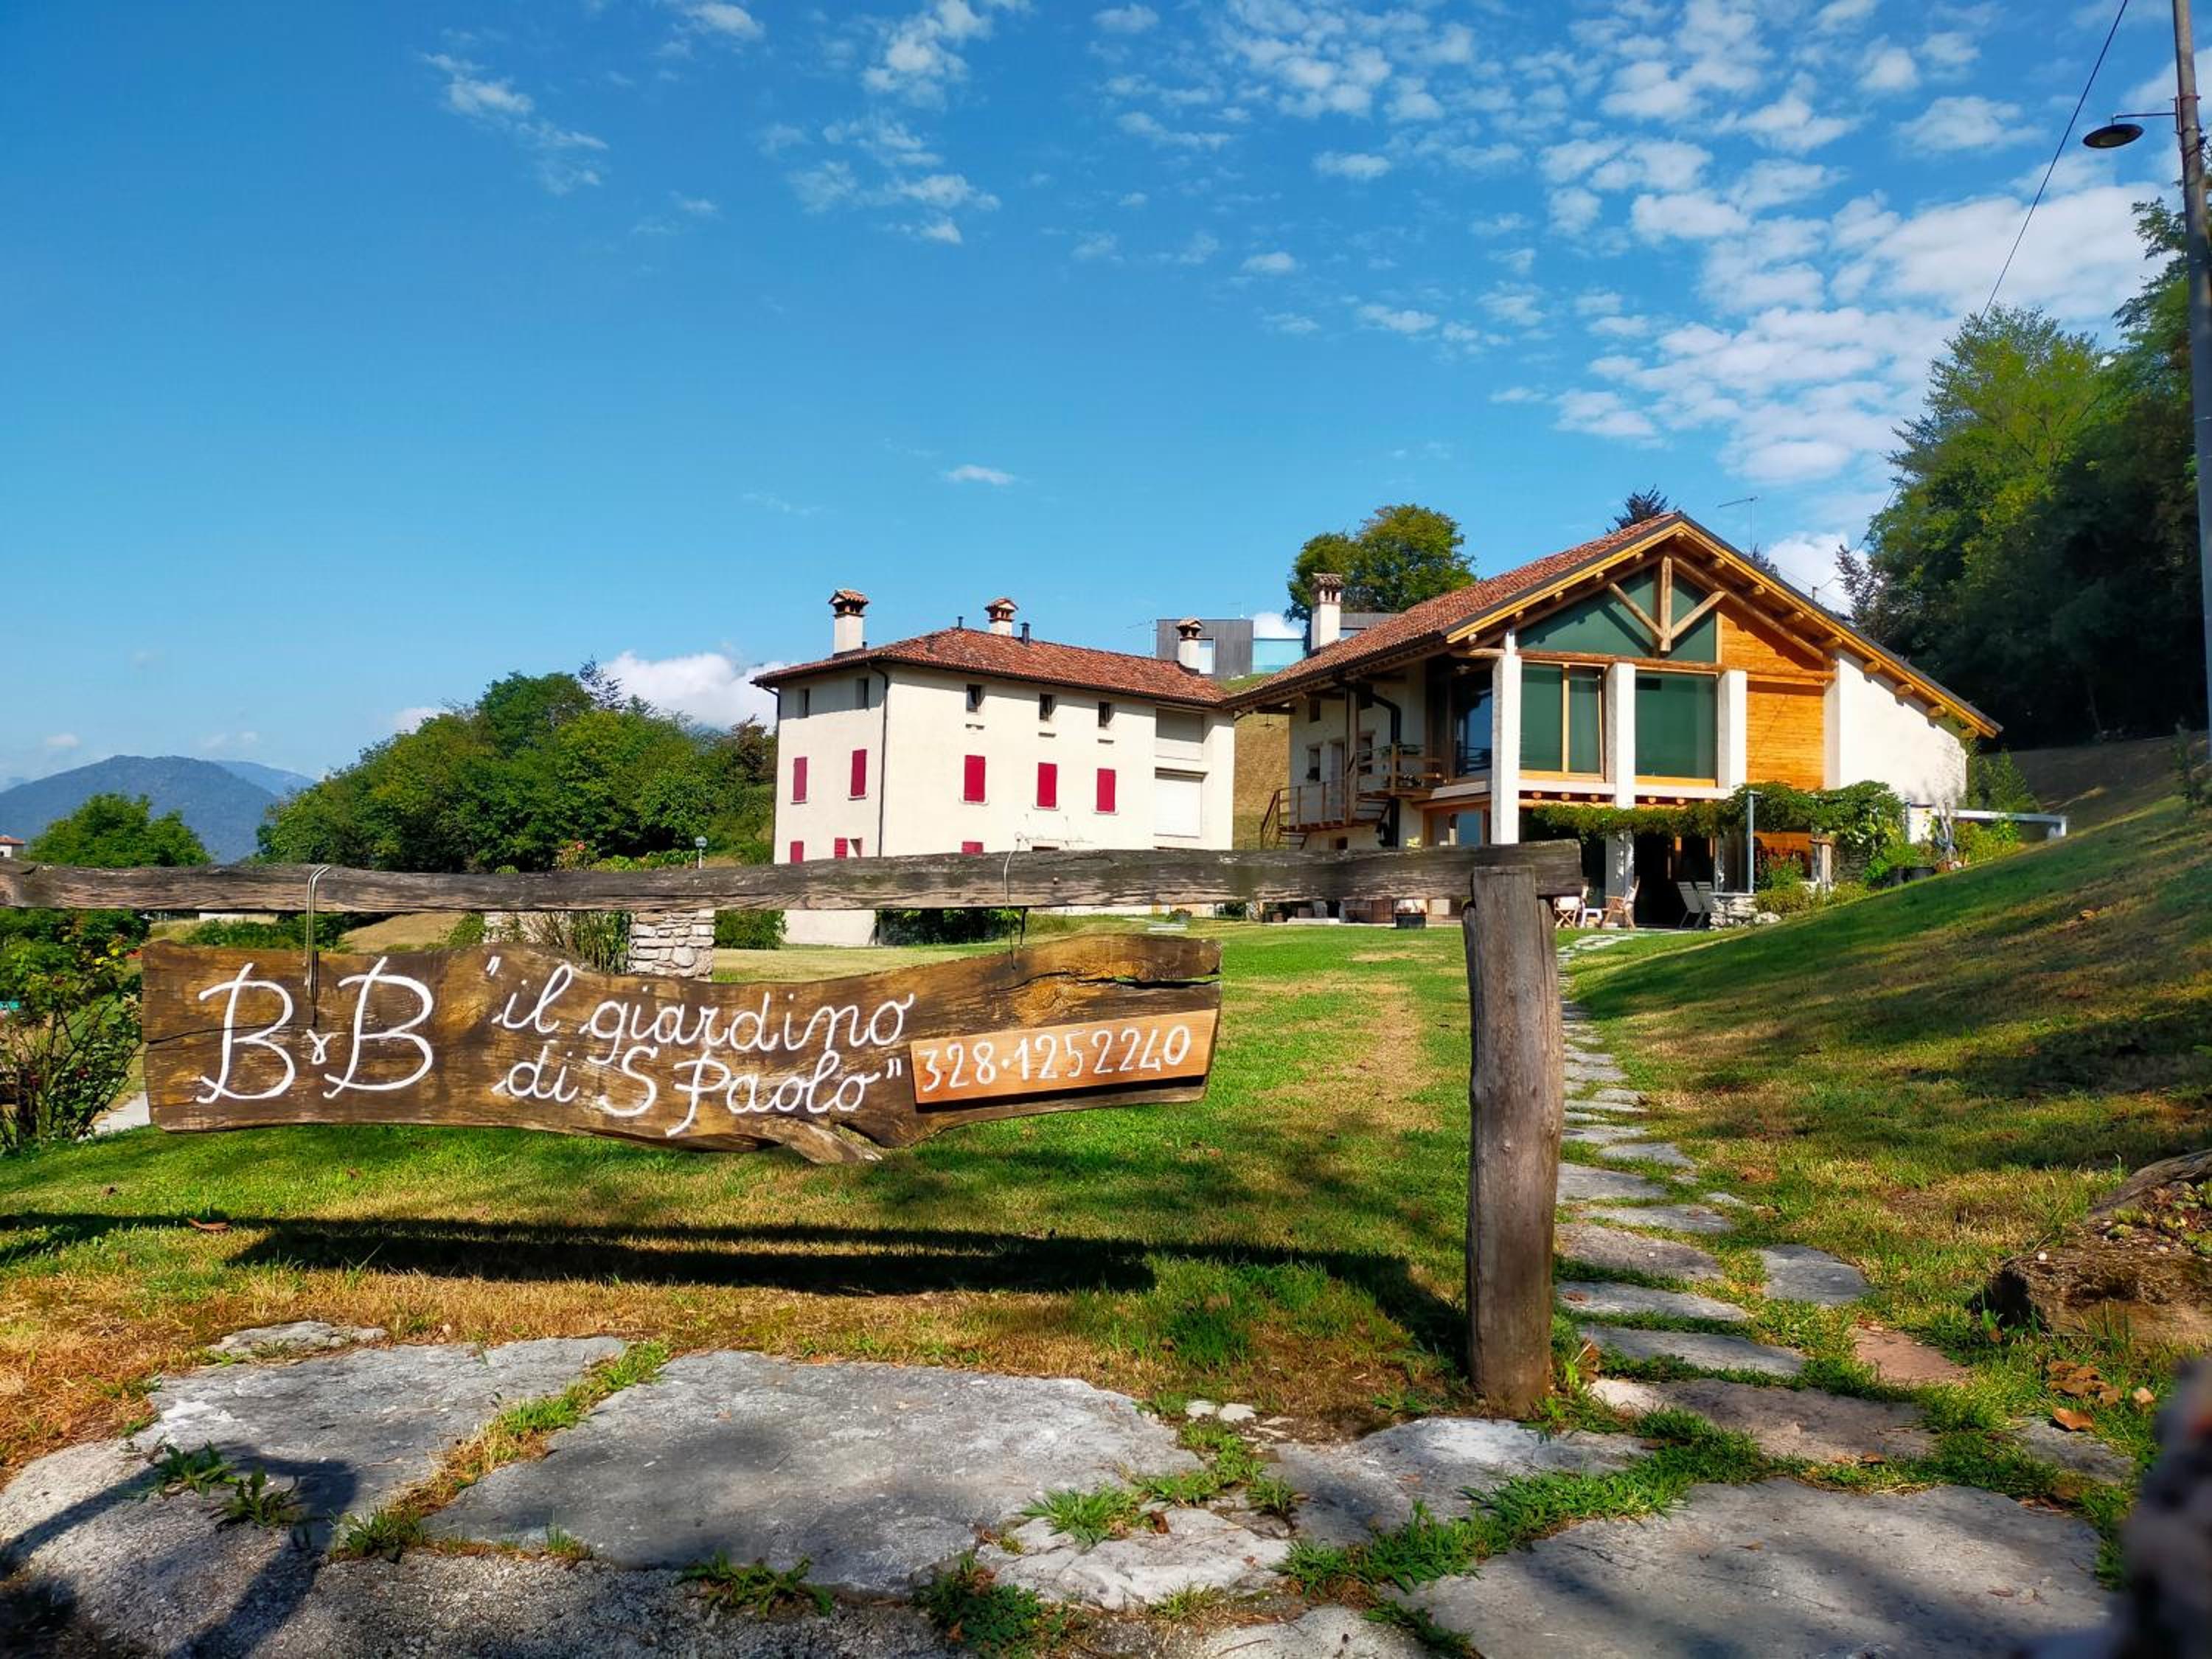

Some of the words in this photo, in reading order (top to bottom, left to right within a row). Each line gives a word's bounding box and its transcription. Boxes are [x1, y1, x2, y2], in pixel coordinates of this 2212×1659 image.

[486, 956, 573, 1033] "il
[578, 985, 915, 1065] giardino
[490, 1044, 579, 1102] di
[597, 1045, 658, 1118] S
[665, 1049, 902, 1138] Paolo"
